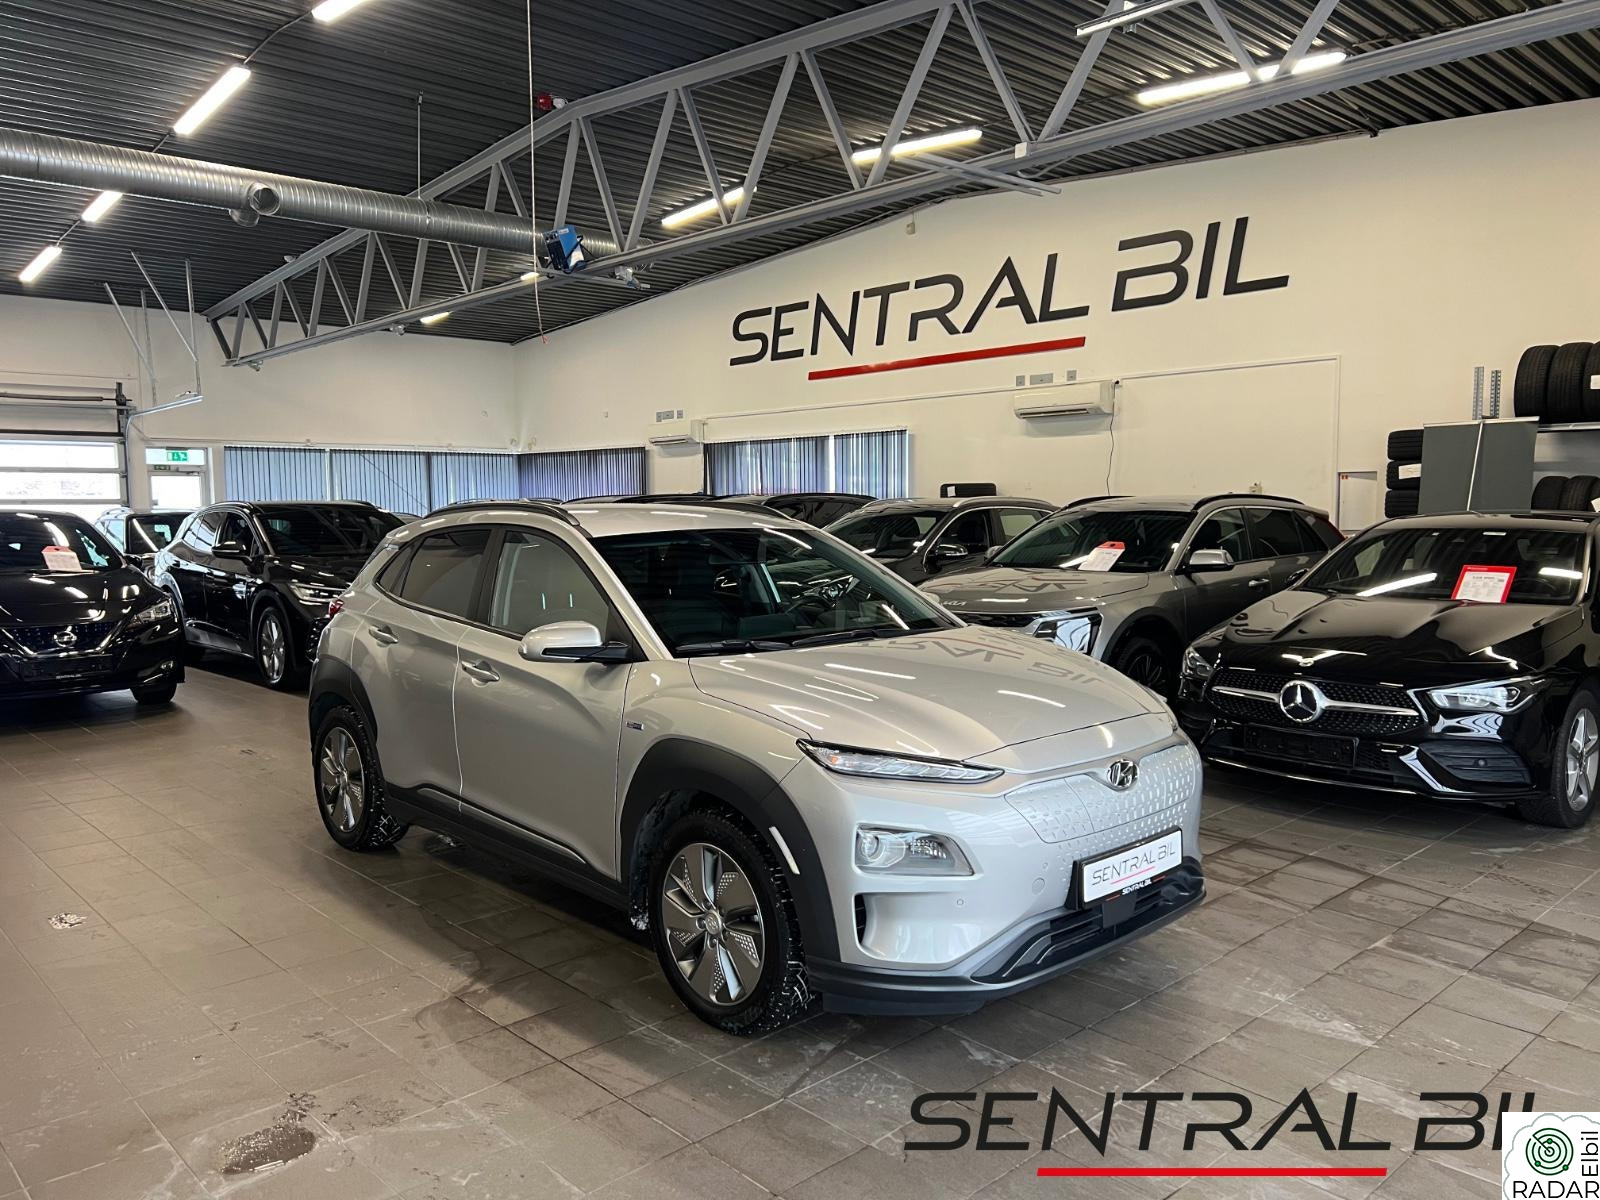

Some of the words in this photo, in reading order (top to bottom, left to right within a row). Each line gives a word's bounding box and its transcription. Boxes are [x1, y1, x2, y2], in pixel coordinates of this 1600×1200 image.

[730, 252, 1089, 366] SENTRAL
[1112, 216, 1289, 312] BIL
[1092, 850, 1155, 886] SENTRAL
[1158, 842, 1176, 860] BIL
